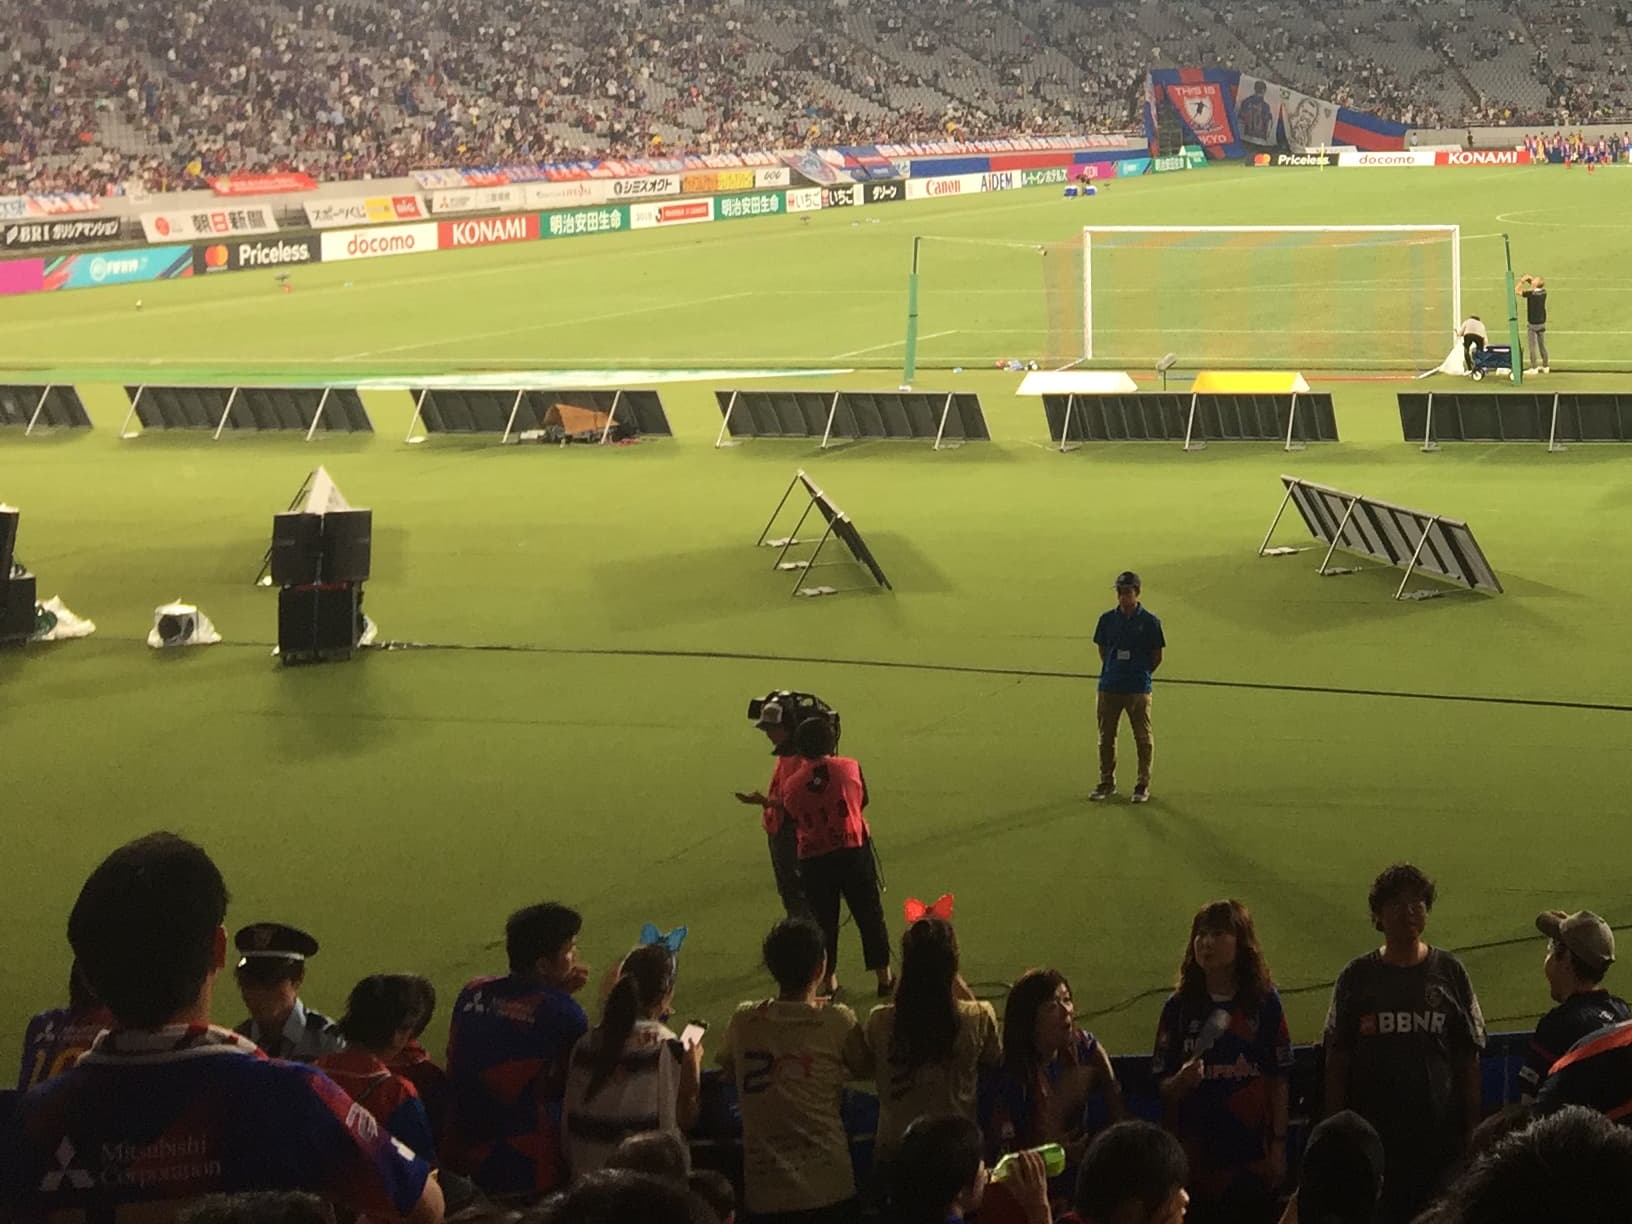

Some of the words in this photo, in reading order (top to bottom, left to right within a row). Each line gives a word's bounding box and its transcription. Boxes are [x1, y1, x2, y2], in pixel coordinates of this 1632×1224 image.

[1359, 153, 1415, 165] docomo
[1448, 151, 1518, 164] KONAMI
[624, 179, 673, 195] シミズオクト
[925, 179, 961, 196] Canon
[720, 194, 780, 216] 明治安田生命
[795, 192, 820, 209] いちご
[829, 188, 854, 206] いちご
[549, 208, 622, 236] 明治安田生命
[452, 217, 527, 246] KONAMI
[347, 233, 415, 256] docomo
